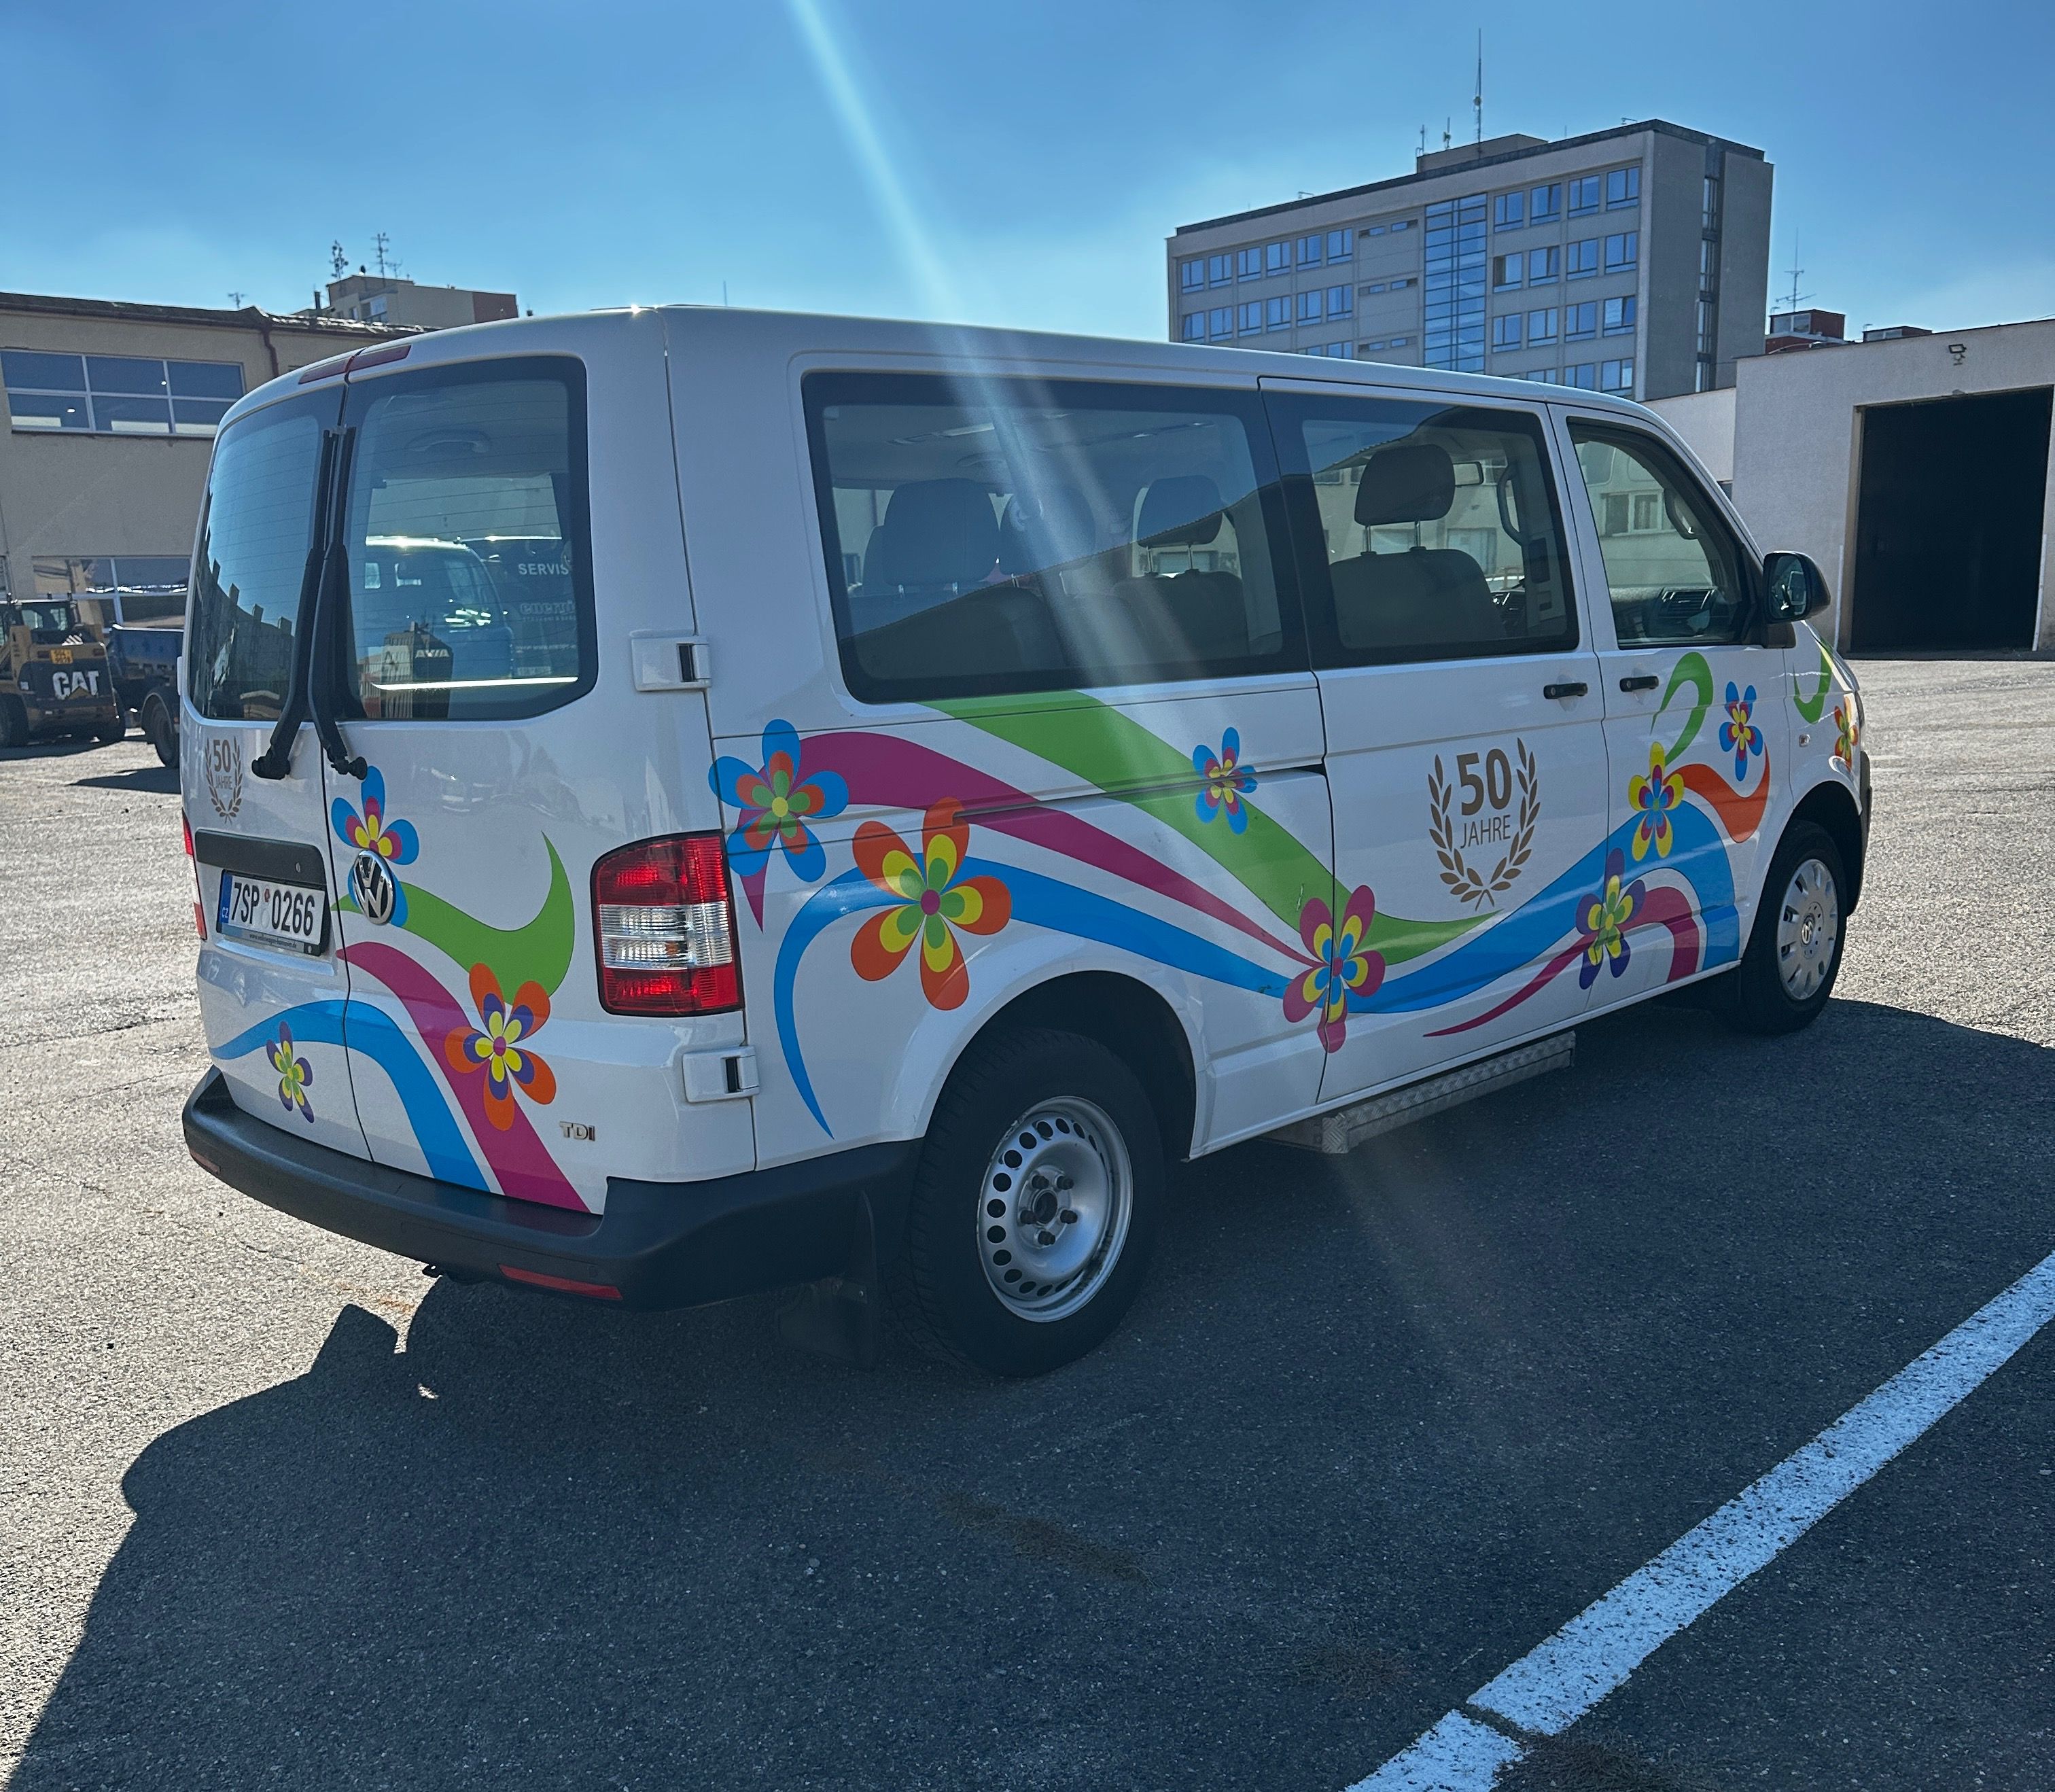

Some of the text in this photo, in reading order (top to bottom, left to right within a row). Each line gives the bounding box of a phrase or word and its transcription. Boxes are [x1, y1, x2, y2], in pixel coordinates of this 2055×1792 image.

[518, 563, 569, 576] SERVIS
[415, 648, 450, 658] AVIA
[52, 670, 99, 700] CAT
[213, 739, 231, 773] 50
[1456, 748, 1512, 815] 50
[1460, 814, 1511, 849] JAHRE
[231, 881, 315, 936] 7SP 0266
[559, 1121, 595, 1142] TDI
